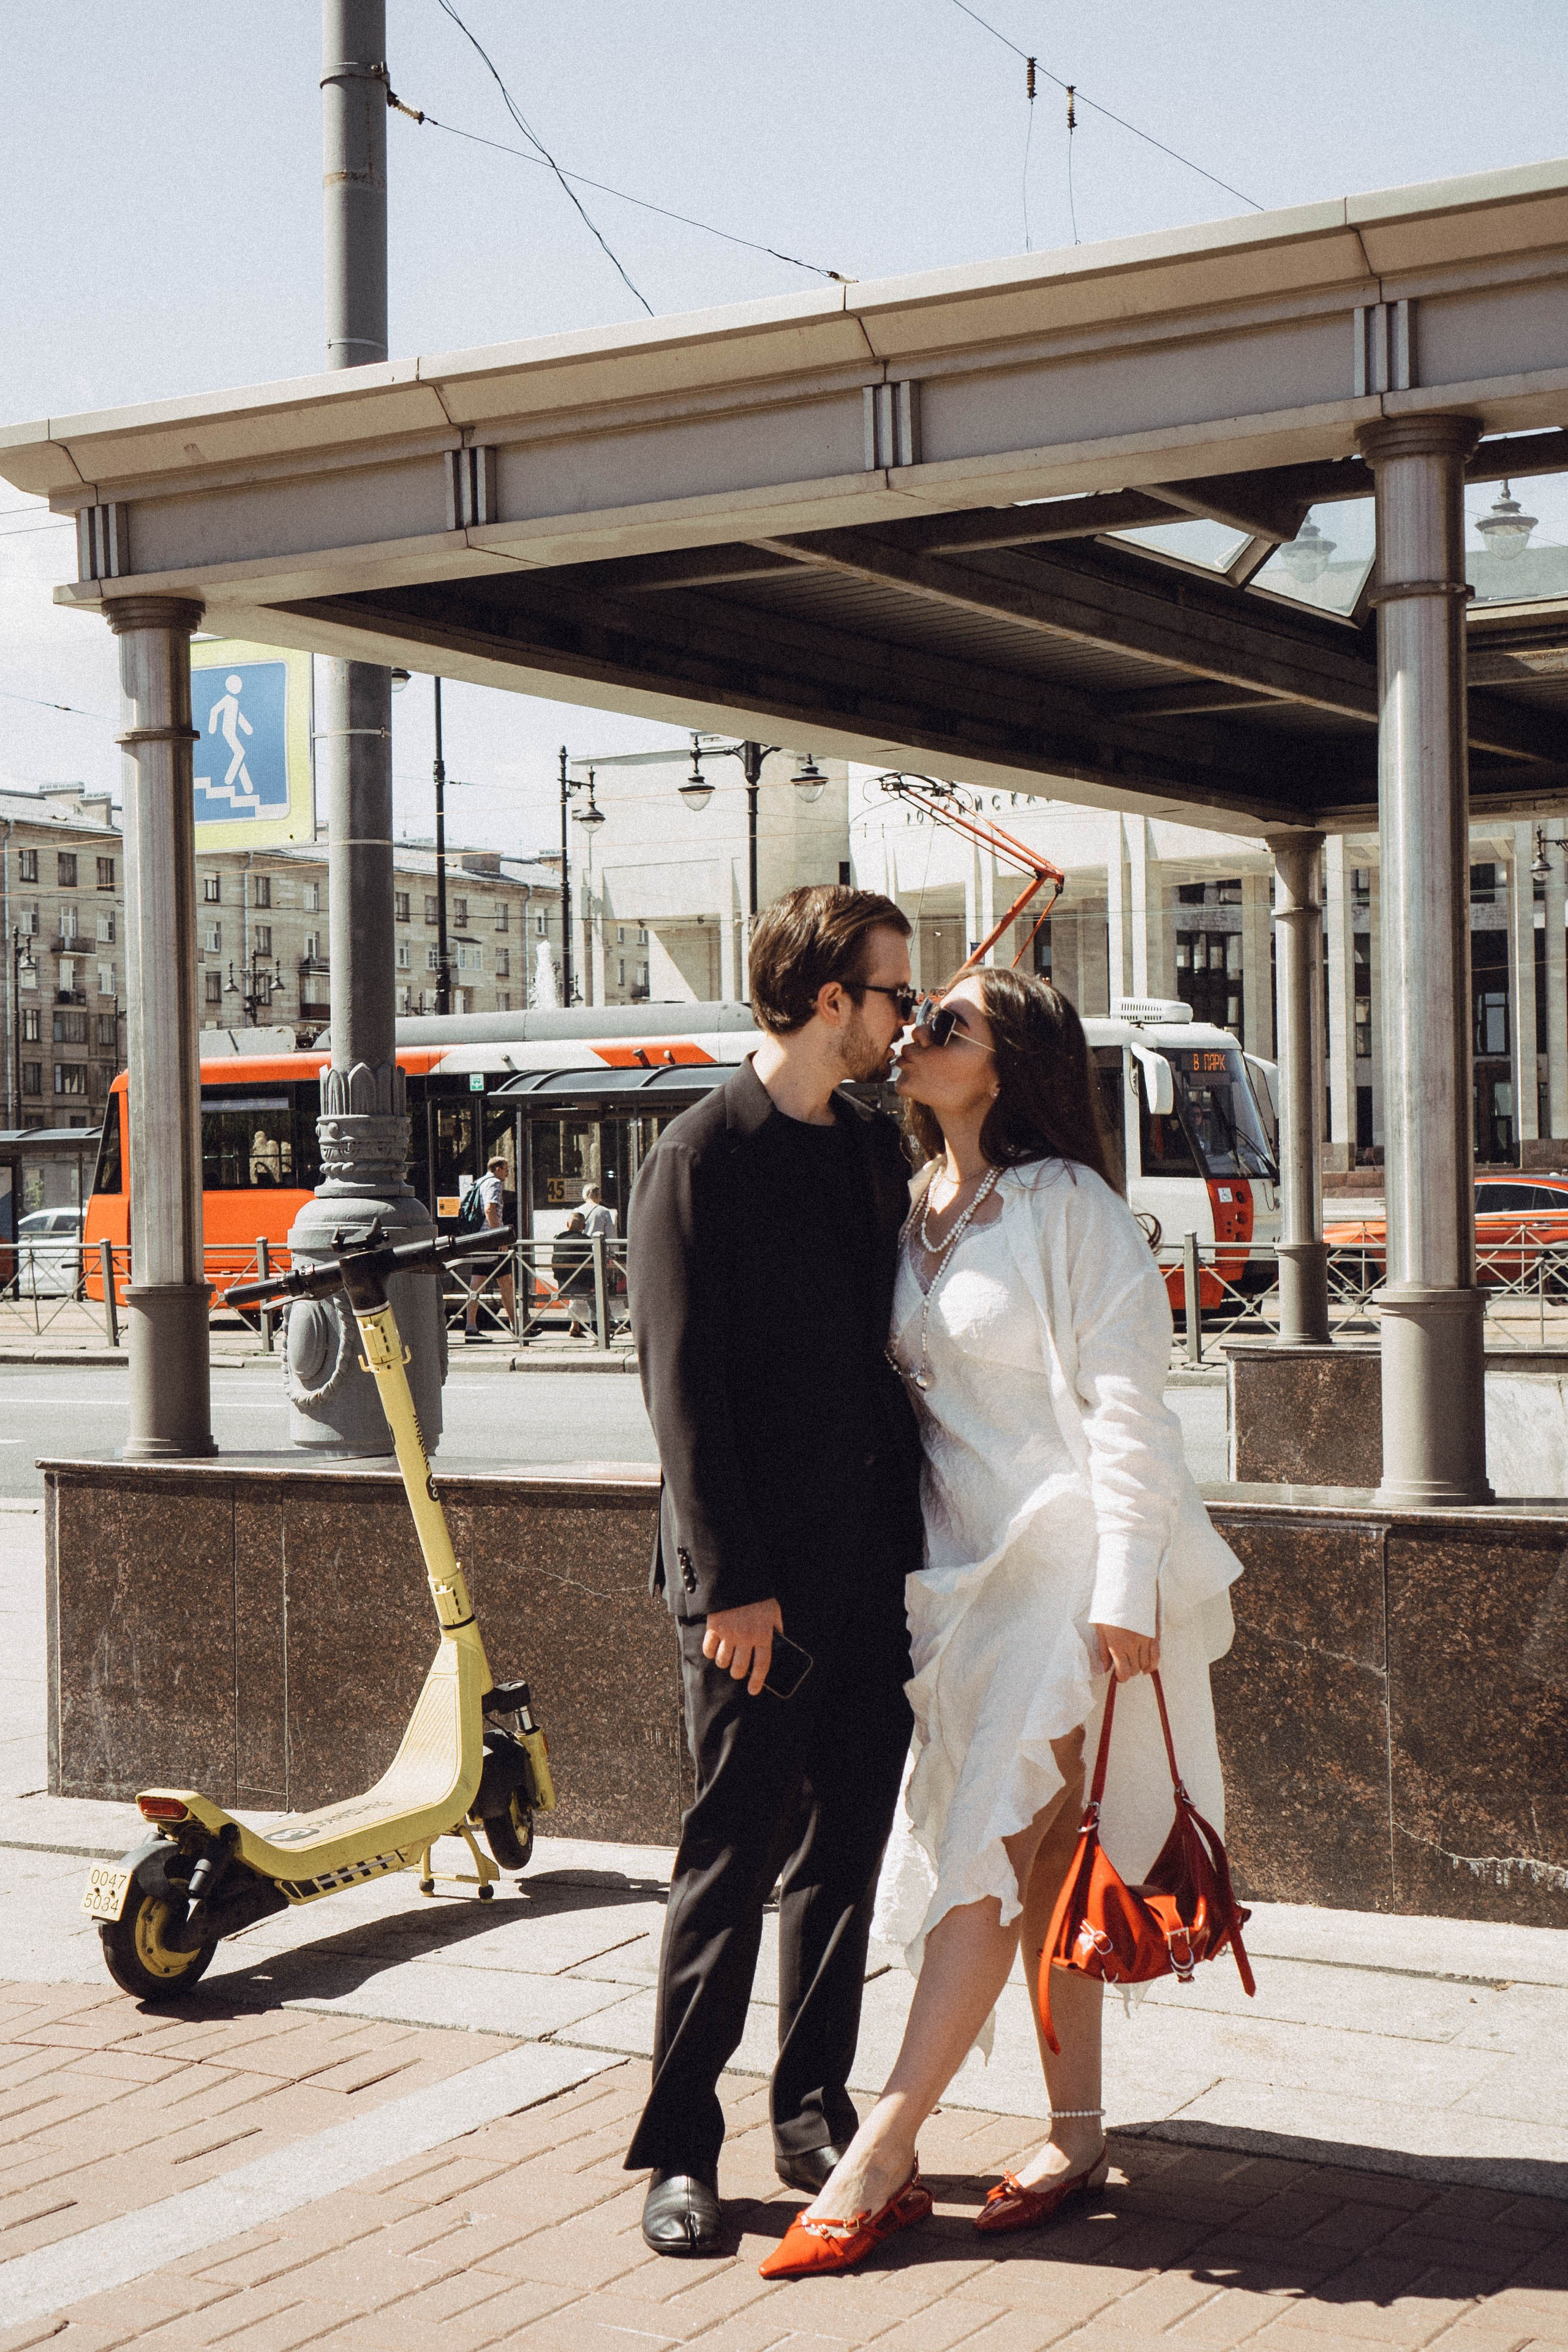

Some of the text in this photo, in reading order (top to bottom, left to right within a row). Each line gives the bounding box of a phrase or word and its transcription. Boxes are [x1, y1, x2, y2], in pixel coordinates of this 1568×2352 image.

[1193, 1053, 1226, 1071] В ПАРК
[548, 1180, 565, 1199] 45
[91, 1869, 127, 1889] 0047
[84, 1893, 119, 1913] 5034
